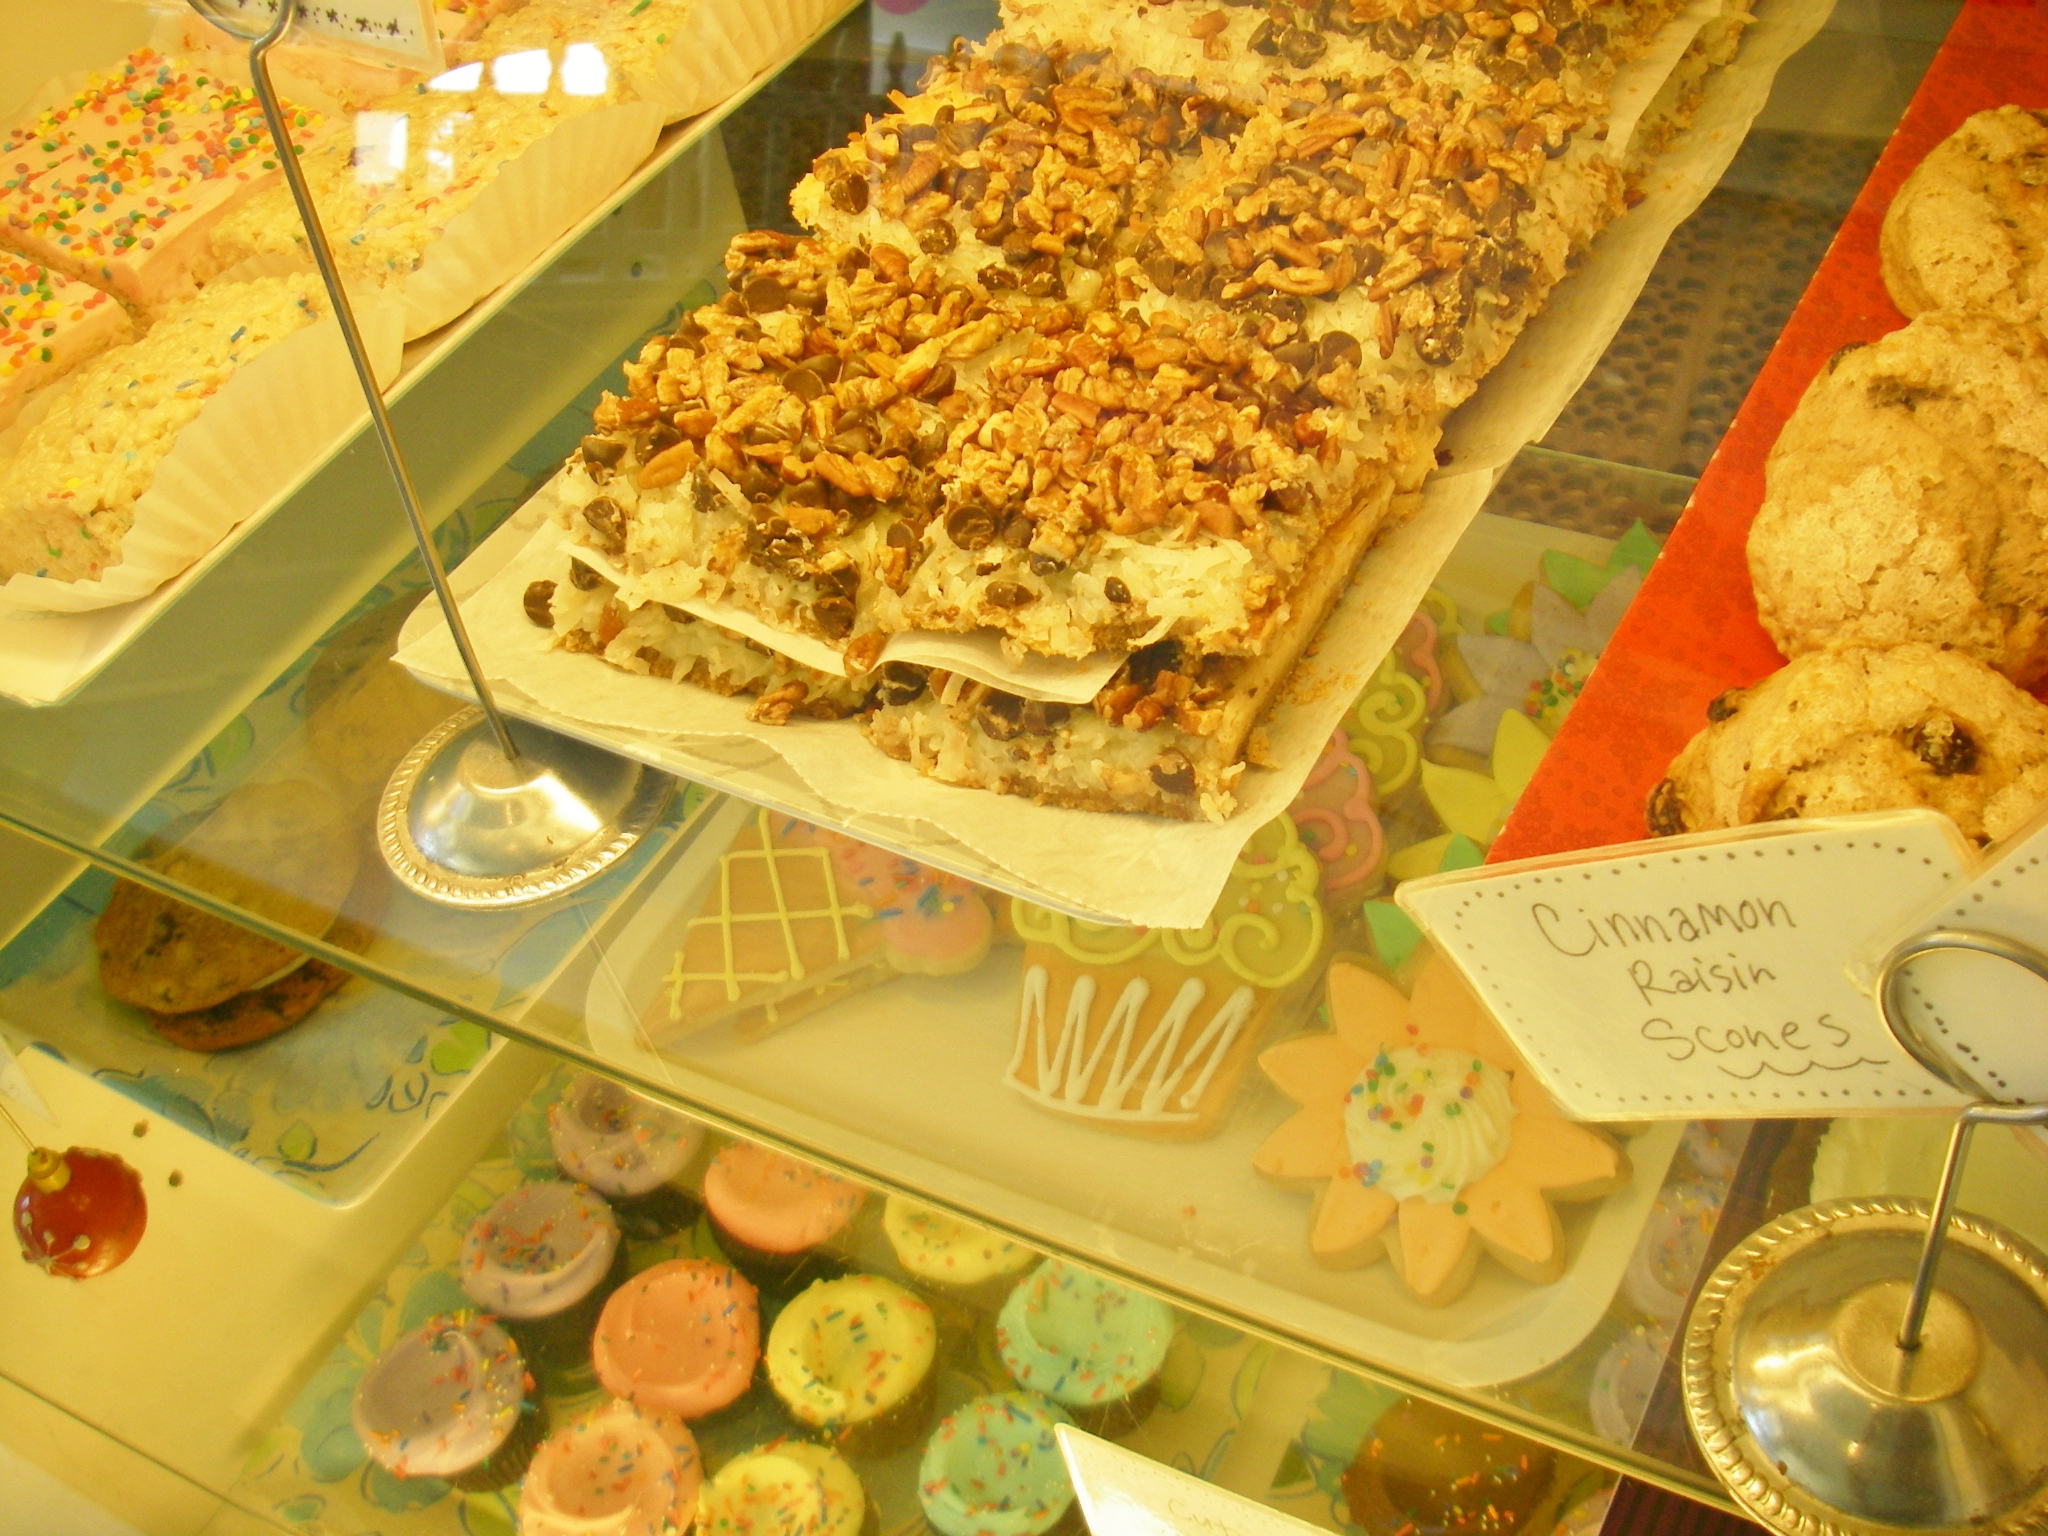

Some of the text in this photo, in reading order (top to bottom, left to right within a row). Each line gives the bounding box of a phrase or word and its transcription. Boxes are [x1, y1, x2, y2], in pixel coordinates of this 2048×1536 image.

[1531, 897, 1798, 957] Cinnamon
[1627, 952, 1778, 1006] Raisin
[1640, 1013, 1851, 1062] Scones
